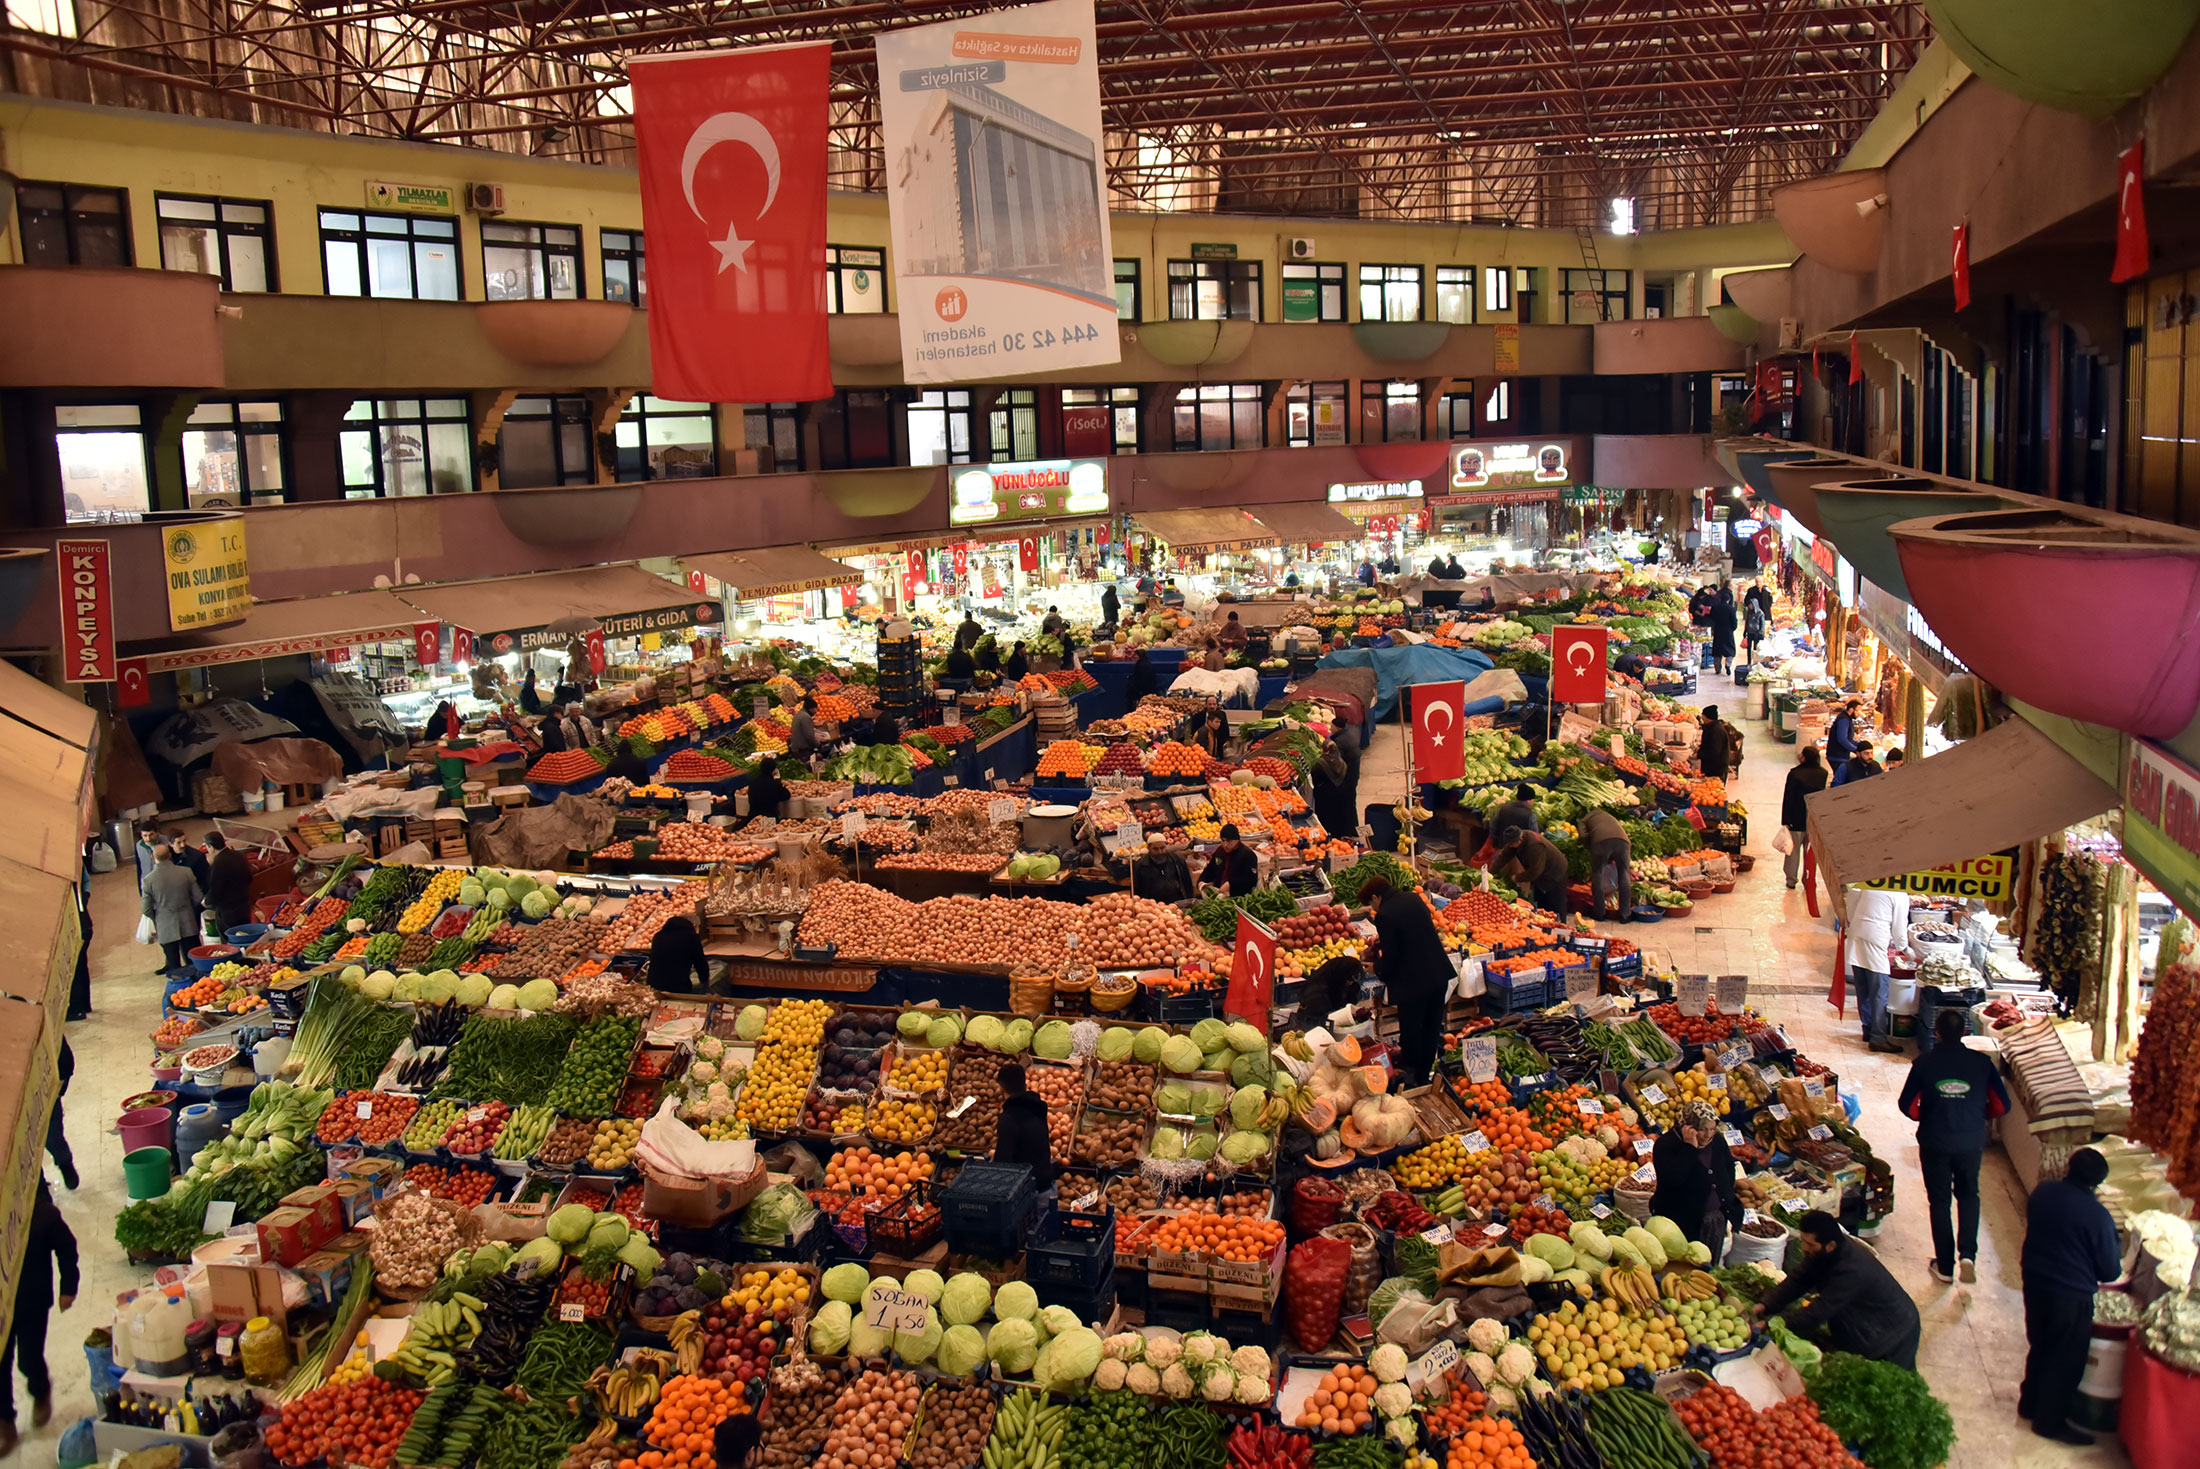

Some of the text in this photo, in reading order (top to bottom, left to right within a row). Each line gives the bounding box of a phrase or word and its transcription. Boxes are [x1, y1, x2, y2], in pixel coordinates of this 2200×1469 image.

[1384, 503, 1403, 514] GIDA
[62, 543, 105, 554] Demirci
[221, 535, 242, 553] T.C.
[1176, 543, 1209, 556] KONYA
[1214, 542, 1234, 552] BAL
[1240, 537, 1276, 550] PAZARI
[171, 571, 192, 590] OVA
[192, 565, 227, 587] SULAMA
[741, 573, 863, 599] TEMİZOĞLU GIDA PAZARI
[198, 588, 226, 606] KONYA
[71, 555, 102, 677] KONPEYSA
[520, 631, 567, 648] ERMAN
[645, 615, 653, 627] &
[656, 608, 689, 626] GIDA
[163, 628, 410, 669] BOĞAZİÇİ GIDA
[1864, 873, 2001, 897] OHUMCU
